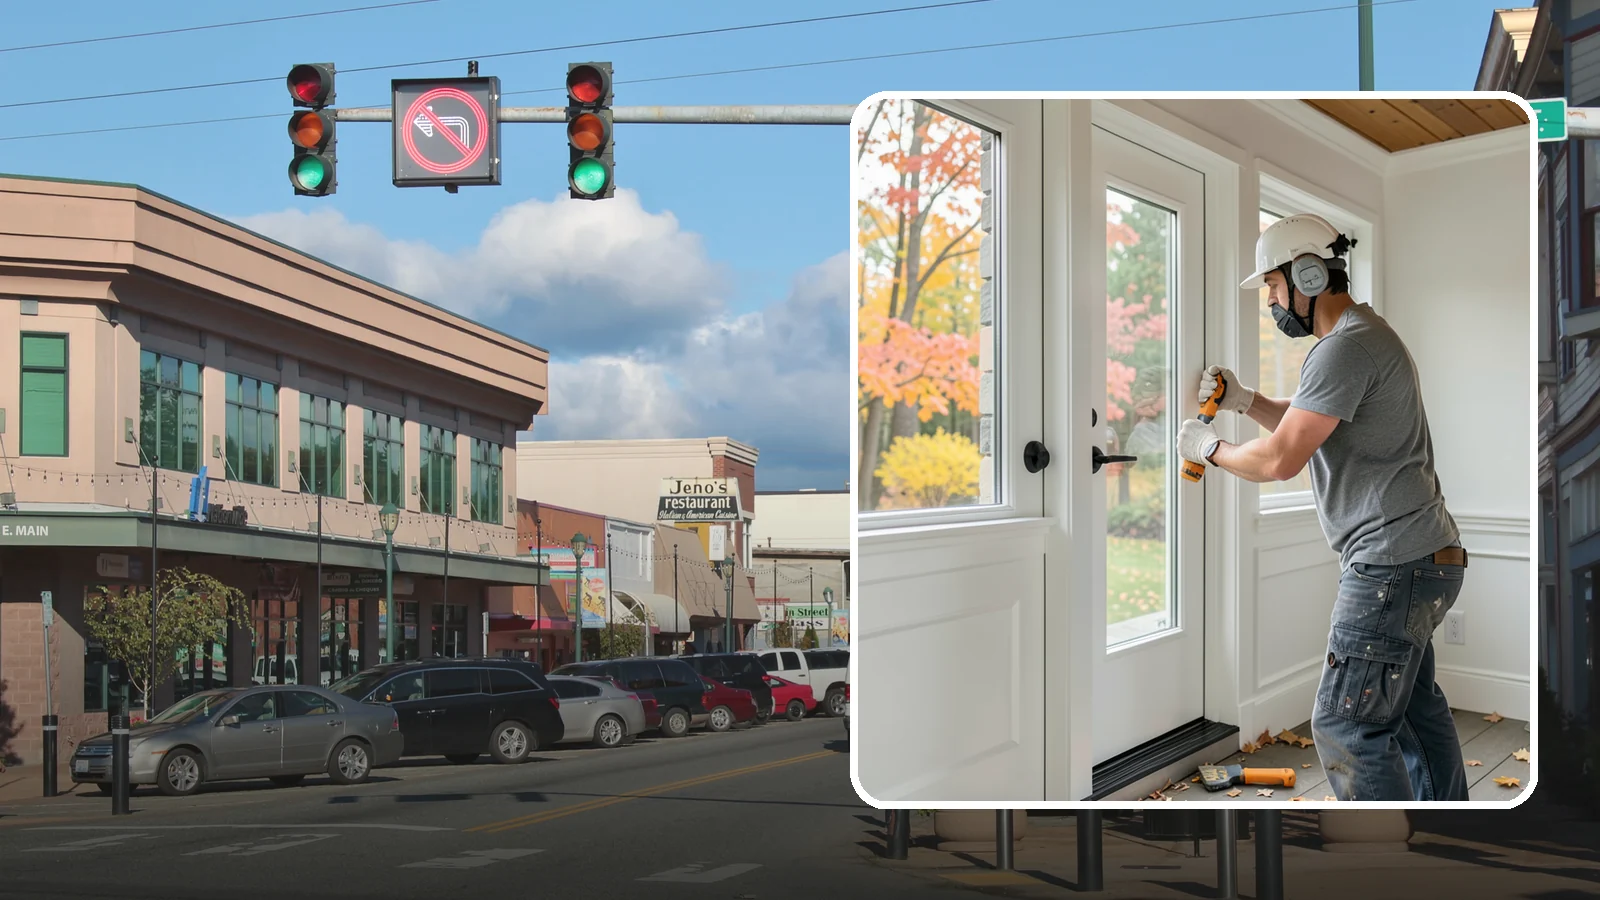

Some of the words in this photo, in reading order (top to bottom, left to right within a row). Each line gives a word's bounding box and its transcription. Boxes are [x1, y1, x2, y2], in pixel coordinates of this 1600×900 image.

[670, 480, 727, 495] Jeno's
[665, 496, 731, 509] restaurant
[658, 510, 681, 520] Italian
[686, 509, 714, 520] American
[715, 509, 738, 520] Cuisine
[2, 525, 13, 536] E.
[15, 525, 49, 536] MAIN
[797, 607, 829, 617] Street
